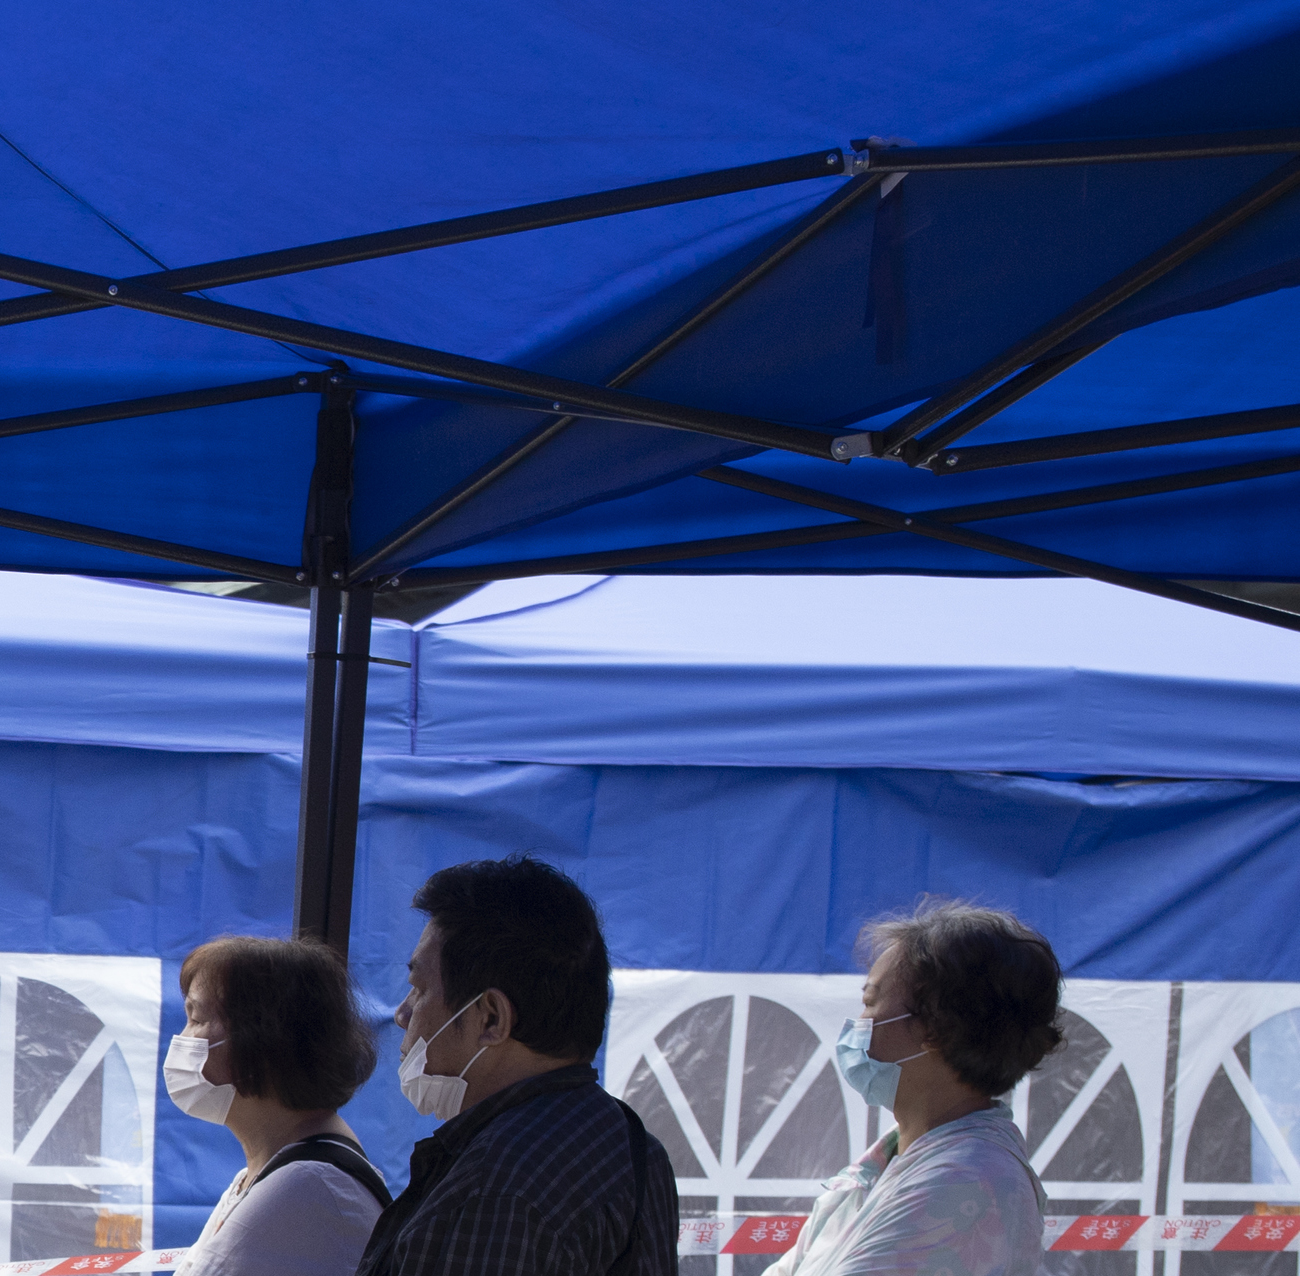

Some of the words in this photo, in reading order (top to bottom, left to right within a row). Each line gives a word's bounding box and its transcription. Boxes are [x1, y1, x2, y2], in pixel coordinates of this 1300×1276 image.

[759, 1221, 799, 1229] SAFE
[750, 1229, 790, 1242] 安全
[1080, 1226, 1121, 1240] 安全
[1244, 1227, 1283, 1240] 安全
